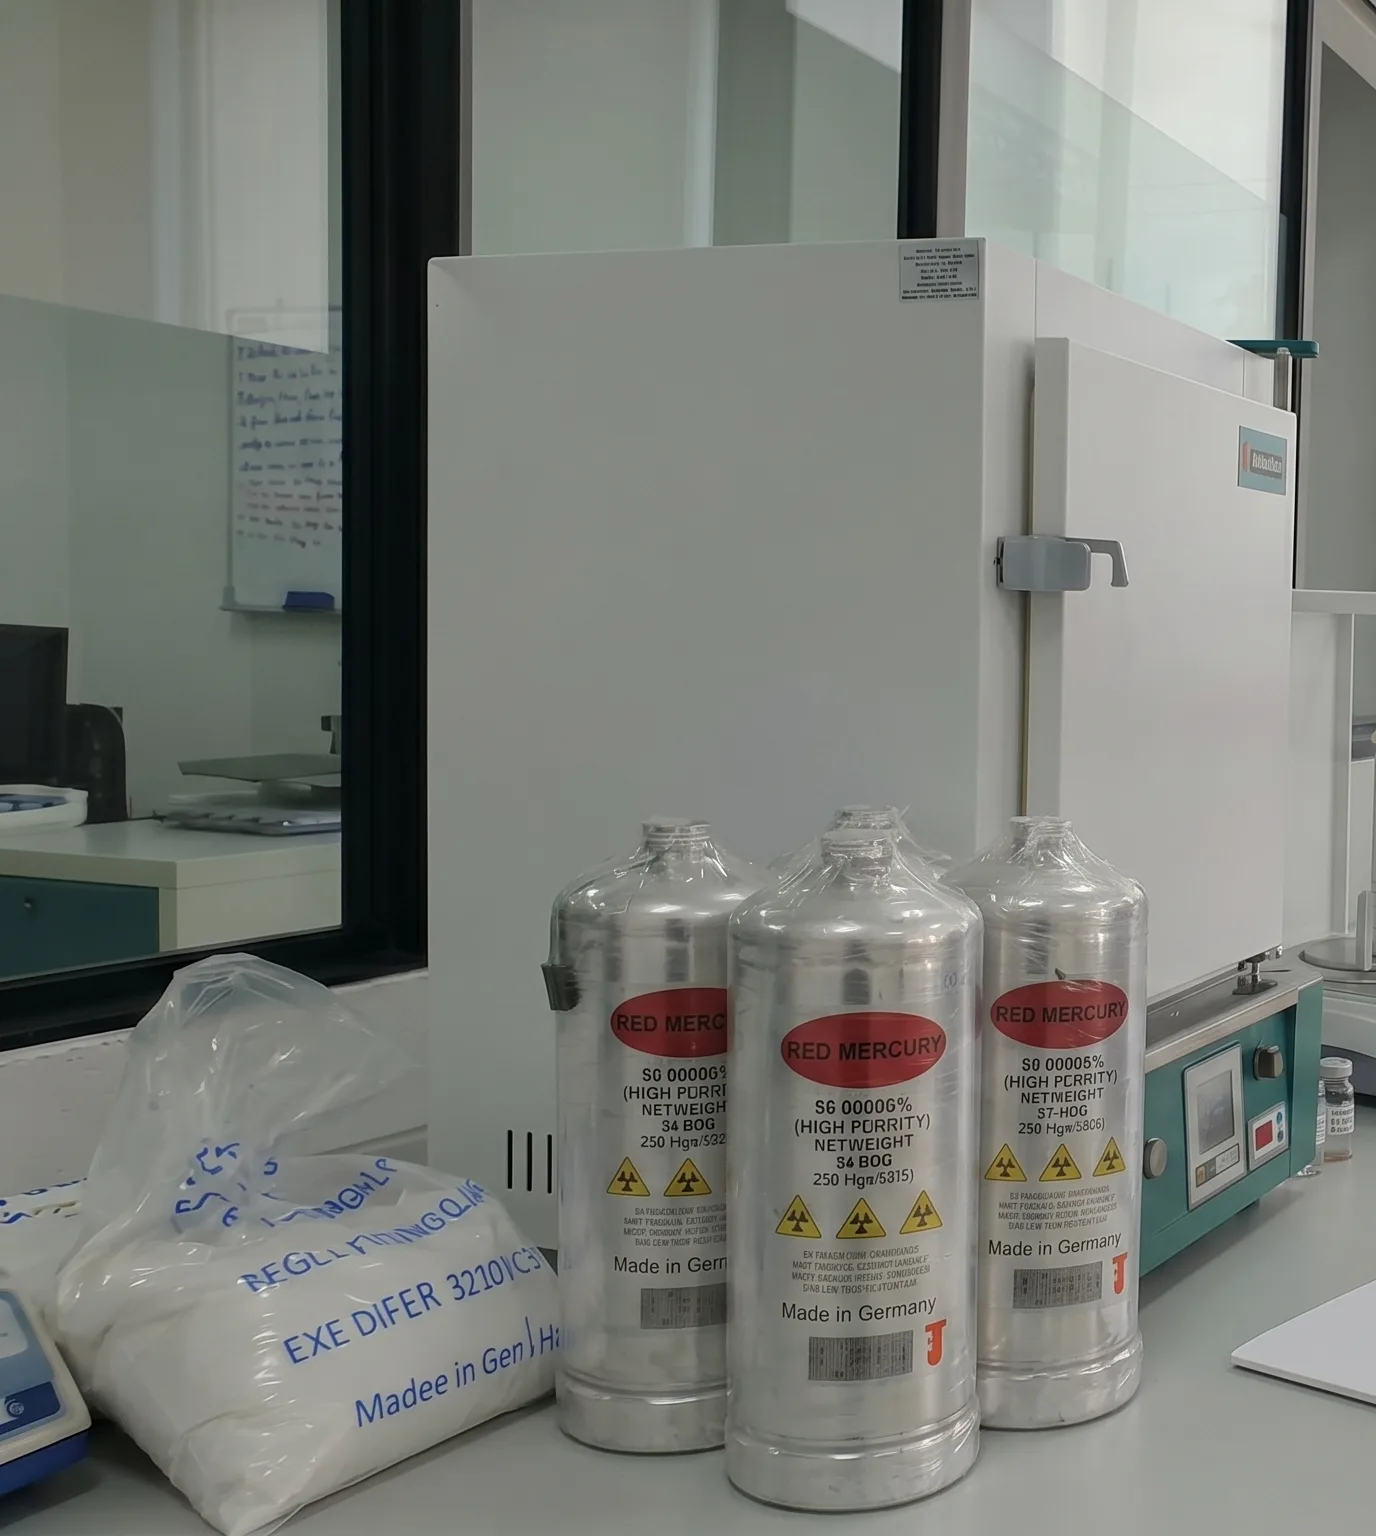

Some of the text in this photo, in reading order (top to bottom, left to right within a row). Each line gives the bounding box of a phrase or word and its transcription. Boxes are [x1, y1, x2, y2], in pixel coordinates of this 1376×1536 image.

[995, 1000, 1126, 1024] RED MERCURY
[616, 1013, 727, 1033] RED MERC
[787, 1034, 942, 1061] RED MERCURY
[1003, 1074, 1049, 1092] (HIGH
[623, 1085, 672, 1103] (HIGH
[641, 1100, 727, 1117] NETWEIGH
[682, 1117, 716, 1132] BOG
[794, 1118, 844, 1137] (HIGH
[1018, 1122, 1042, 1135] 250
[640, 1135, 666, 1149] 250
[814, 1133, 914, 1152] NETWEIGHT
[858, 1153, 893, 1169] BOG
[813, 1172, 839, 1187] 250
[988, 1232, 1122, 1257] Made in Germany
[614, 1256, 660, 1274] Made
[666, 1258, 681, 1274] in
[781, 1297, 937, 1323] Made in Germany
[283, 1318, 350, 1365] EXE
[351, 1281, 443, 1337] DIFER
[355, 1373, 448, 1428] Madee
[454, 1361, 475, 1388] in
